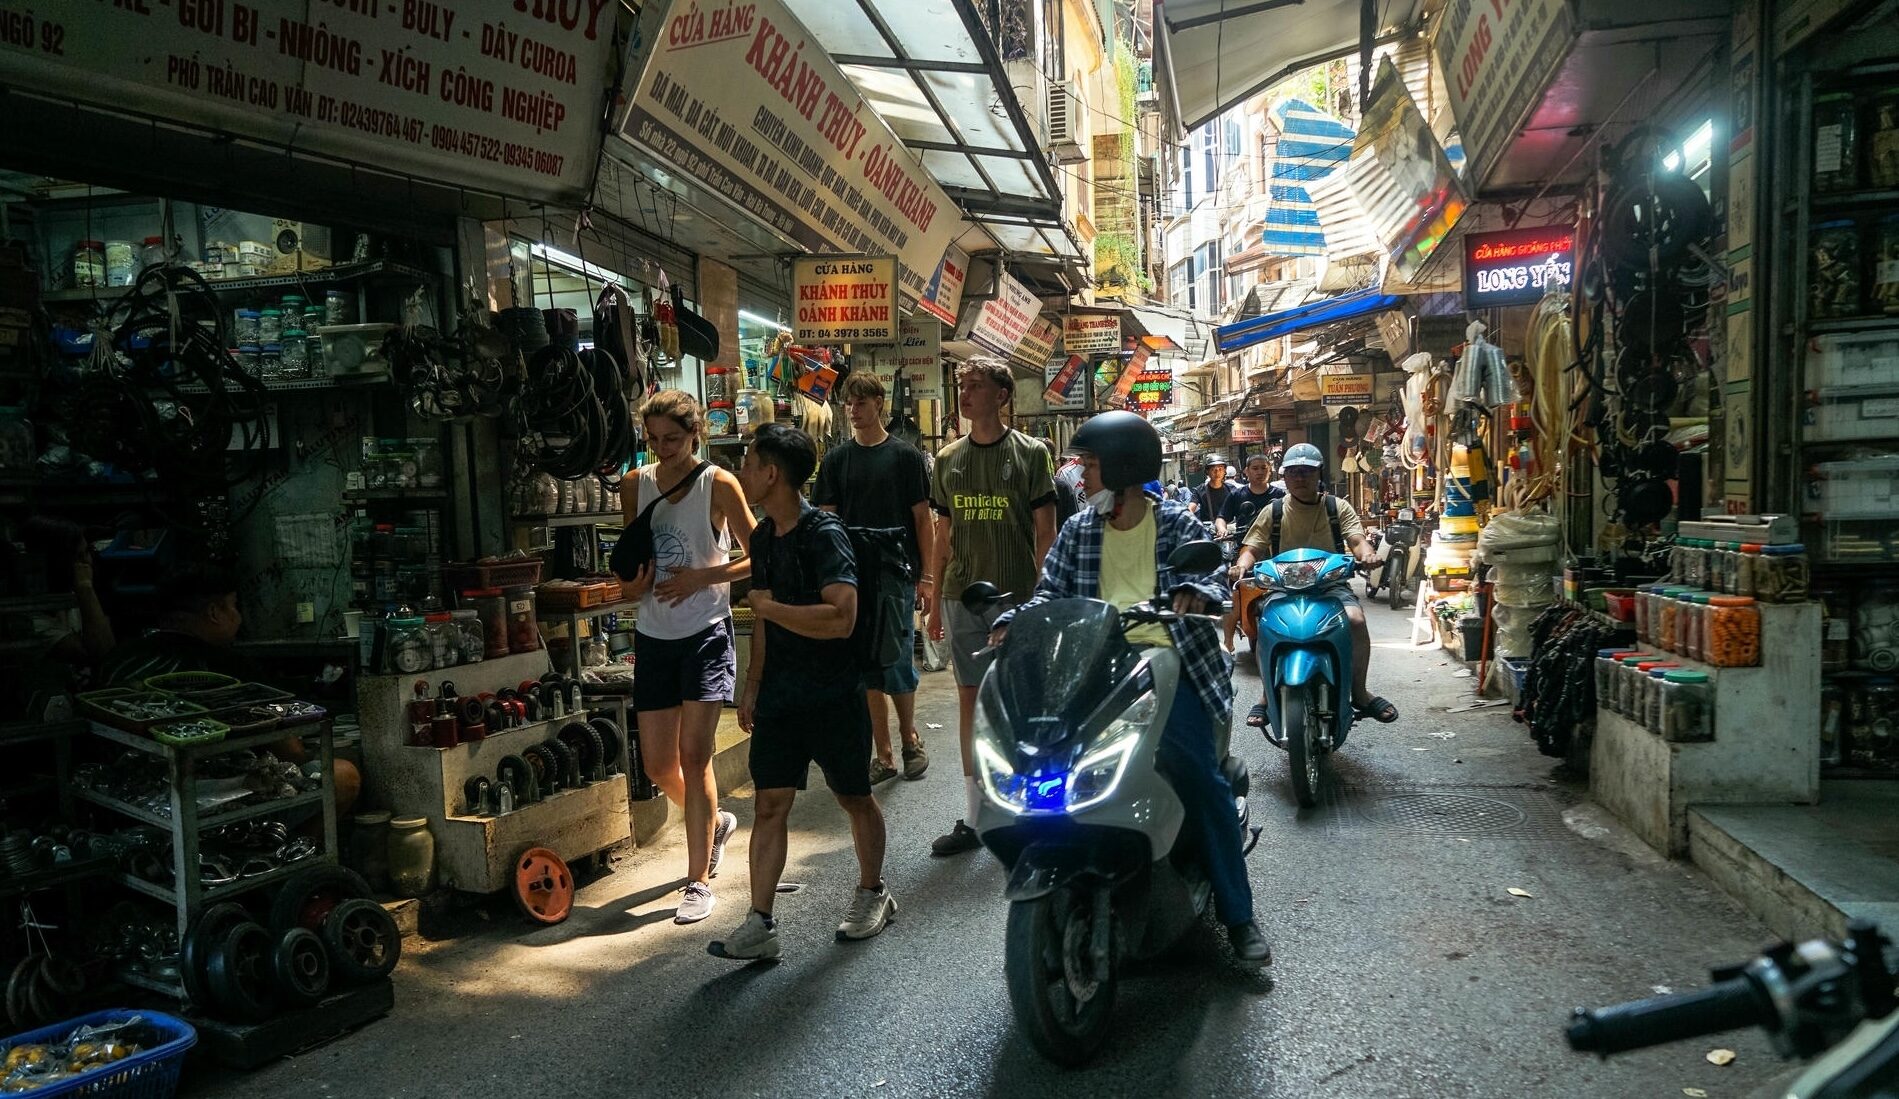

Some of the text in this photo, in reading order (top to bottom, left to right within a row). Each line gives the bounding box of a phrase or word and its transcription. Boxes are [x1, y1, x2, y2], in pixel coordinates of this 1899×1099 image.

[41, 19, 65, 56] 92
[669, 1, 756, 47] CỬA HÀNG
[233, 3, 259, 47] BI
[279, 17, 361, 77] NHÔNG
[440, 66, 494, 113] CÔNG
[480, 21, 518, 63] DÂY
[521, 38, 577, 85] CUROA
[1457, 13, 1493, 102] LONG
[248, 76, 279, 110] CAO
[745, 16, 827, 122] KHÁNH
[816, 100, 868, 160] THỦY
[863, 143, 905, 202] OÁNH
[894, 177, 938, 234] KHÁNH
[815, 261, 873, 275] CỬA HÀNG
[1476, 266, 1529, 293] LONG
[800, 280, 848, 301] KHÁNH
[851, 277, 889, 299] THỦY
[799, 301, 889, 323] OÁNH KHÁNH
[818, 328, 831, 338] 04
[834, 328, 860, 338] 3978
[953, 493, 1009, 508] Emirates
[964, 508, 1003, 520] FLY BETTER
